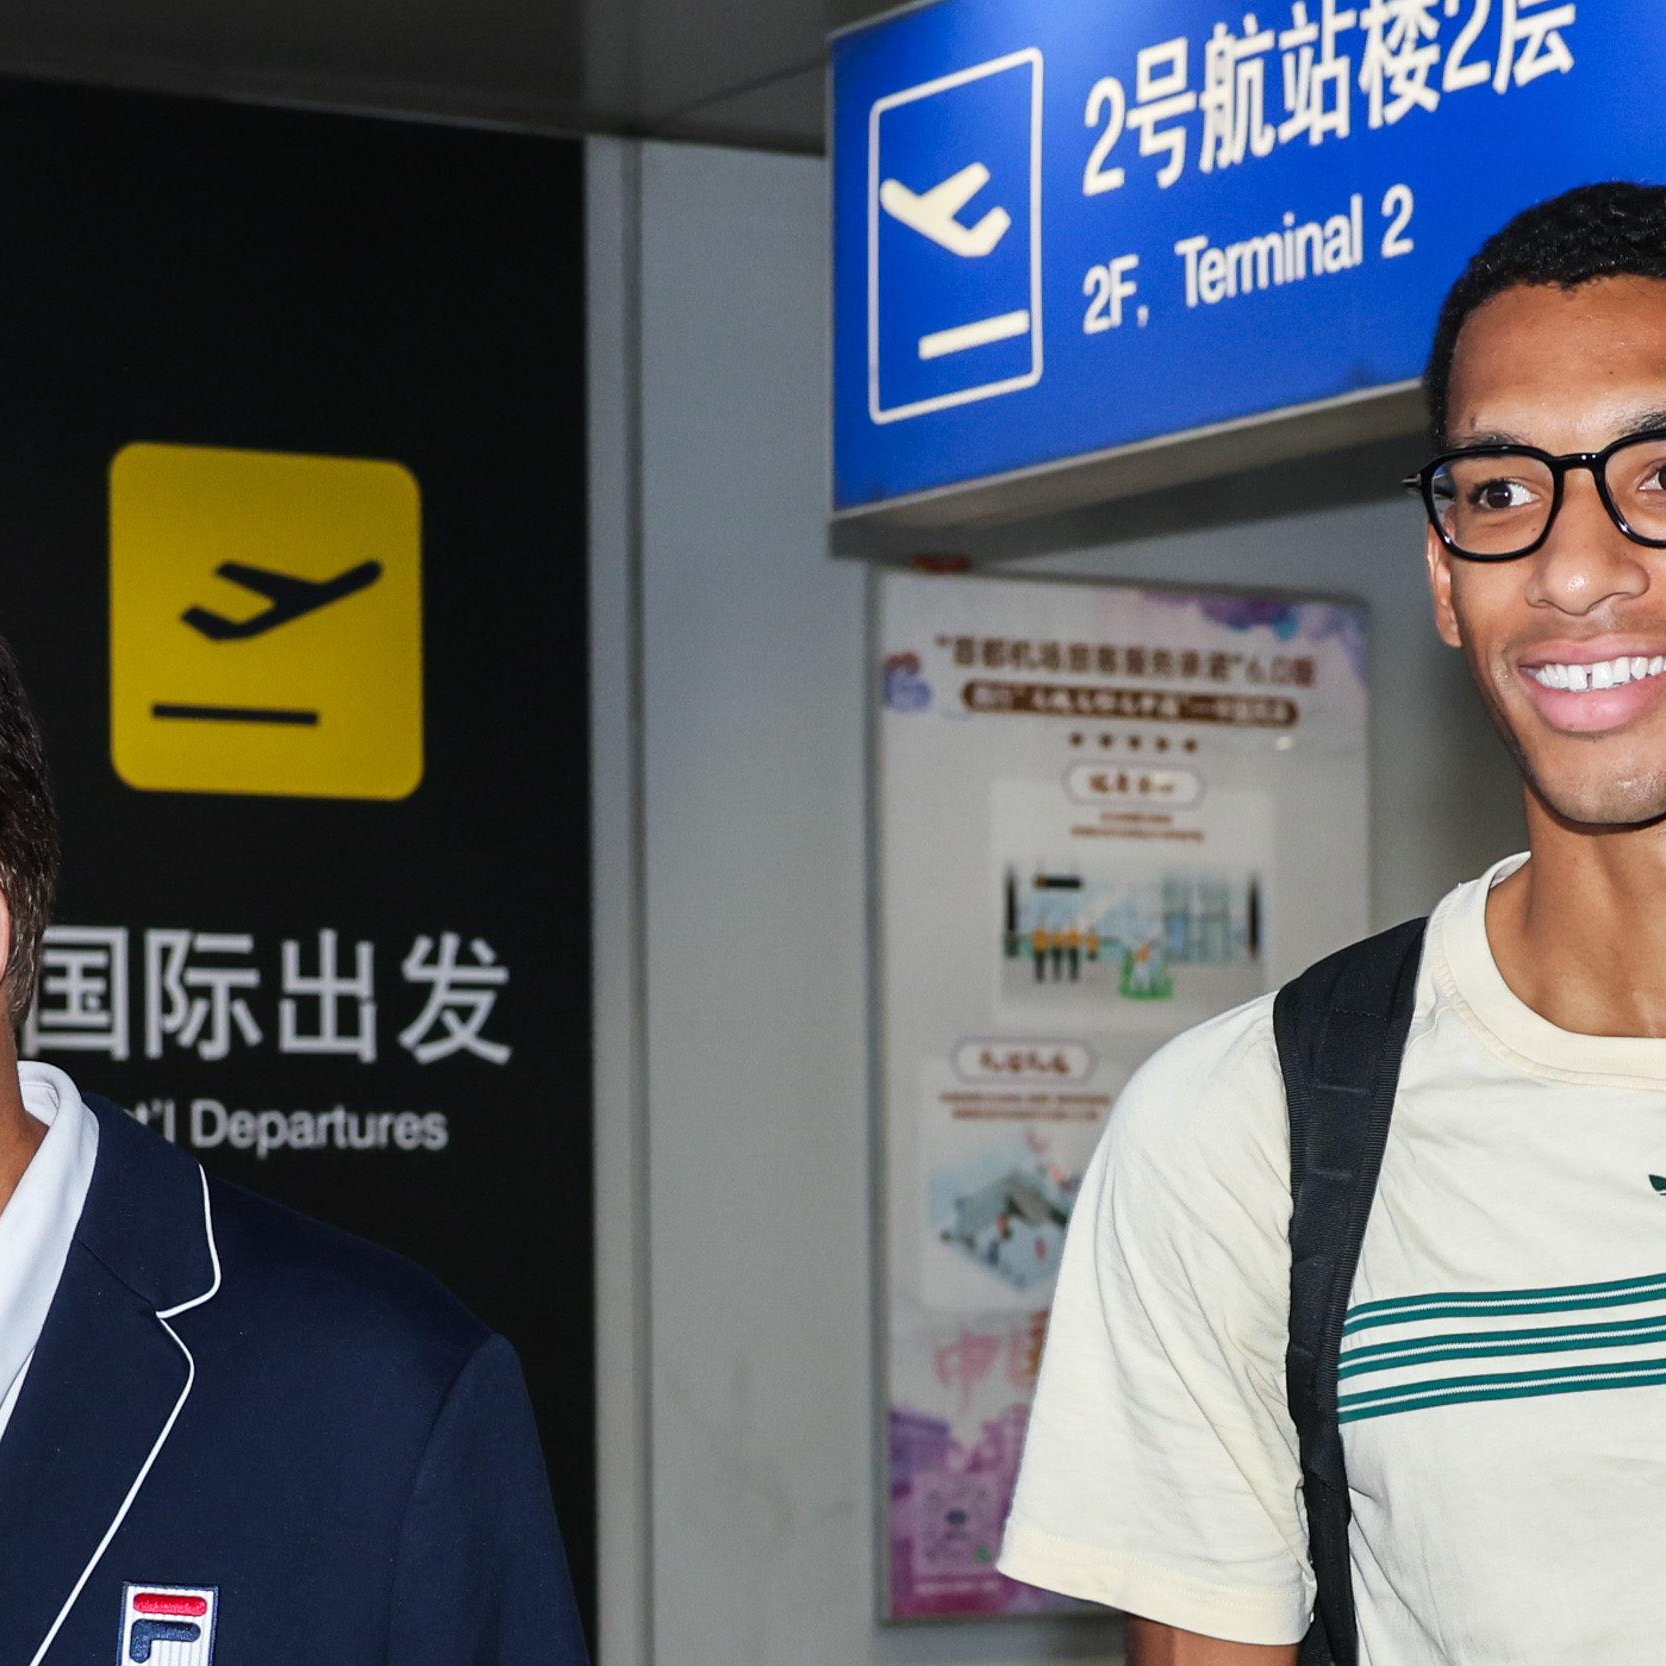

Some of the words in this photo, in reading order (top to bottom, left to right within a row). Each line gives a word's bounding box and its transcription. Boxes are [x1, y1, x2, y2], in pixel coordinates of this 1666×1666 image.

[1083, 0, 1577, 197] 2号航站楼2层
[1175, 194, 1363, 307] Terminal
[1381, 185, 1415, 257] 2
[21, 924, 513, 1067] 国际出发
[190, 1098, 450, 1160] Departures
